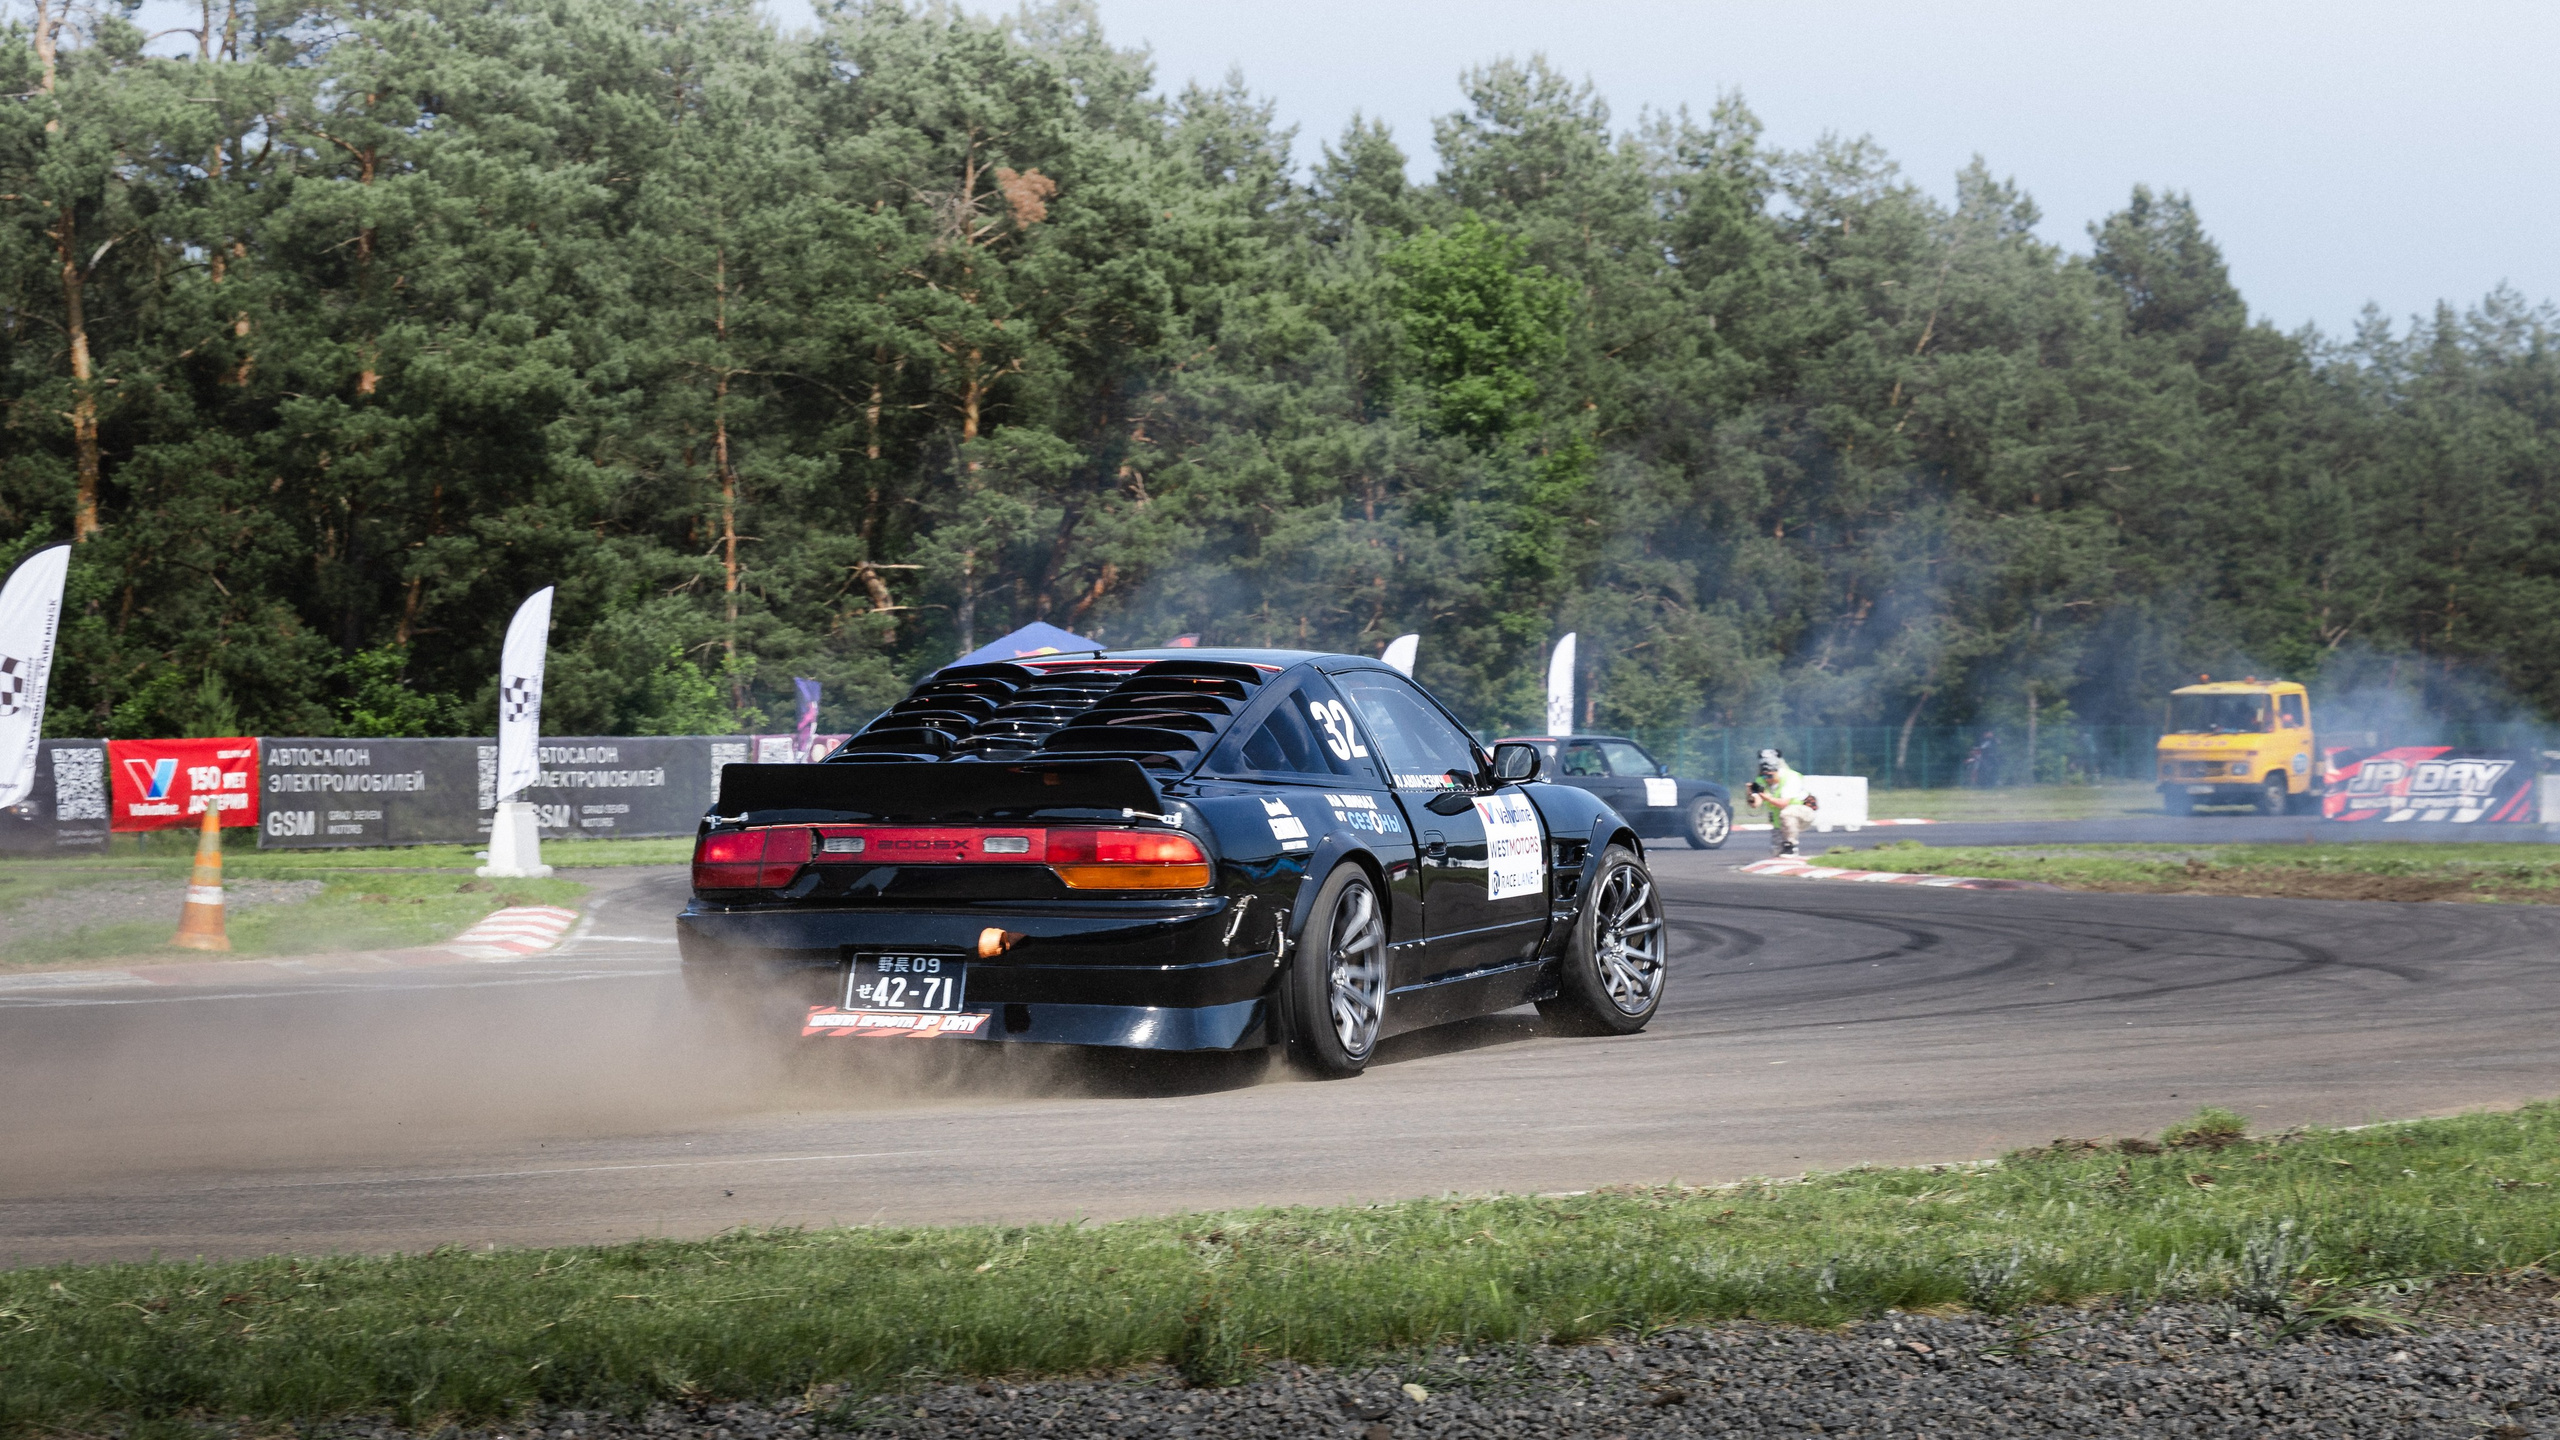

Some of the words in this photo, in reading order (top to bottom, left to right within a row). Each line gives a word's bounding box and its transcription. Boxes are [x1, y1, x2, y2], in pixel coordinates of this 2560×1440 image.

[1310, 699, 1368, 761] 32
[267, 748, 371, 766] АВТОСАЛОН
[538, 746, 619, 764] ВТОСАЛОН
[187, 765, 221, 791] 150
[268, 769, 425, 792] ЭЛЕКТРОМОБИЛЕЙ
[2350, 760, 2405, 793] JP
[2410, 760, 2503, 793] DAY
[1324, 794, 1345, 808] НА
[1339, 794, 1379, 809] ШИНАХ
[266, 810, 315, 836] GSM
[1495, 807, 1532, 824] Valvoline
[877, 840, 970, 850] 200SX
[1490, 836, 1540, 859] WESTMOTORS
[1501, 872, 1517, 889] RACE
[1517, 870, 1534, 887] LANE
[912, 957, 941, 974] 09
[855, 983, 874, 999] せ
[872, 976, 953, 1010] 42-71
[912, 1015, 941, 1031] JP
[938, 1015, 985, 1032] DAY
